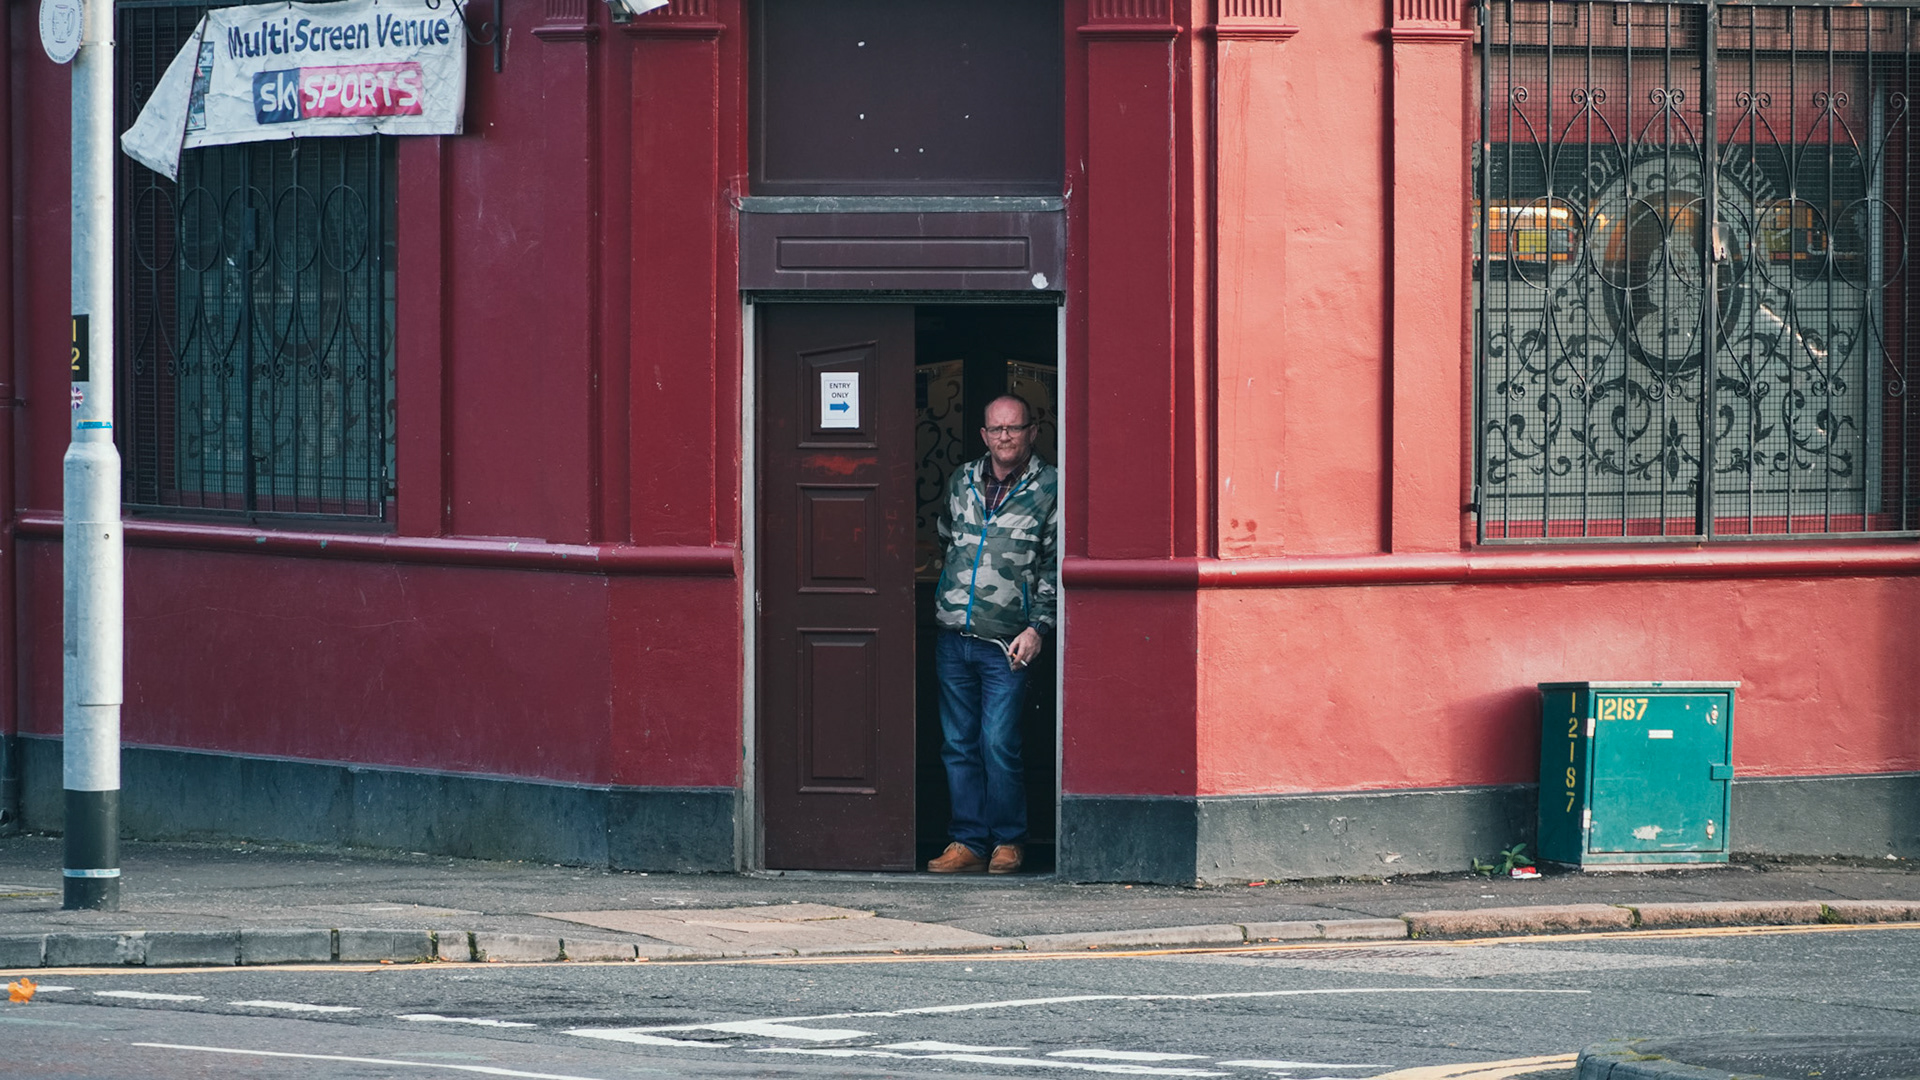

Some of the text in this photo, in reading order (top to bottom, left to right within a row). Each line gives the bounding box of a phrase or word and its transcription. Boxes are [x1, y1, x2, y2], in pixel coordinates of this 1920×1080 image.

[376, 13, 450, 48] Venue
[260, 70, 418, 119] sky SPORTS
[1597, 697, 1649, 721] 12187
